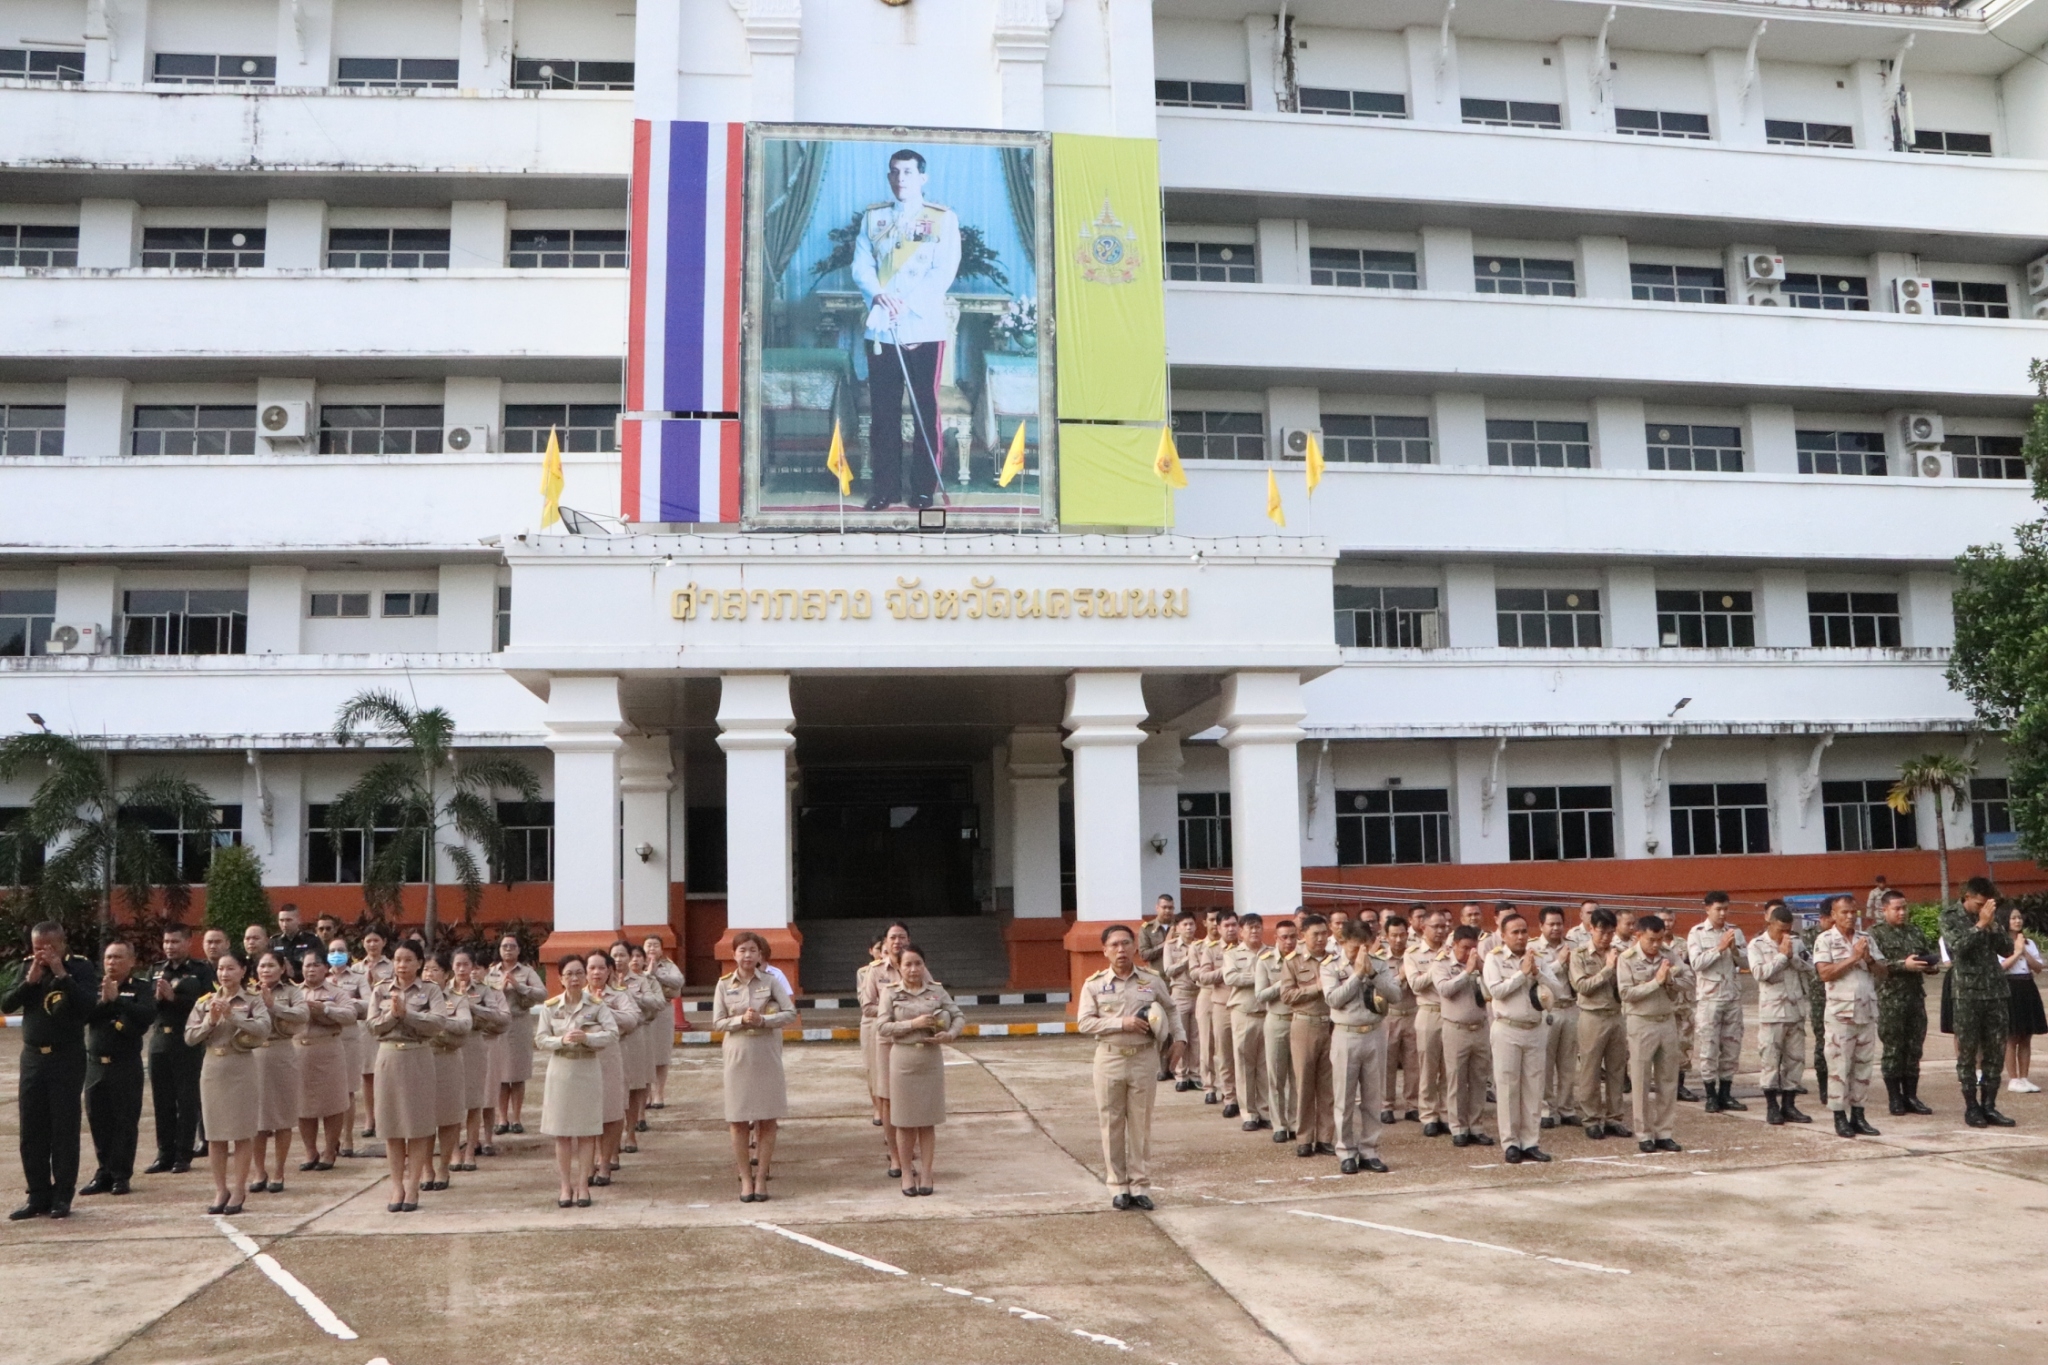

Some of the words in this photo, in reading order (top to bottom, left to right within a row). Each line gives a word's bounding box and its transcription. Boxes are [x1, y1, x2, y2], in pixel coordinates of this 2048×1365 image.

[671, 581, 872, 621] ศาลากลาง
[884, 576, 1189, 620] จังหวัดนครพนม
